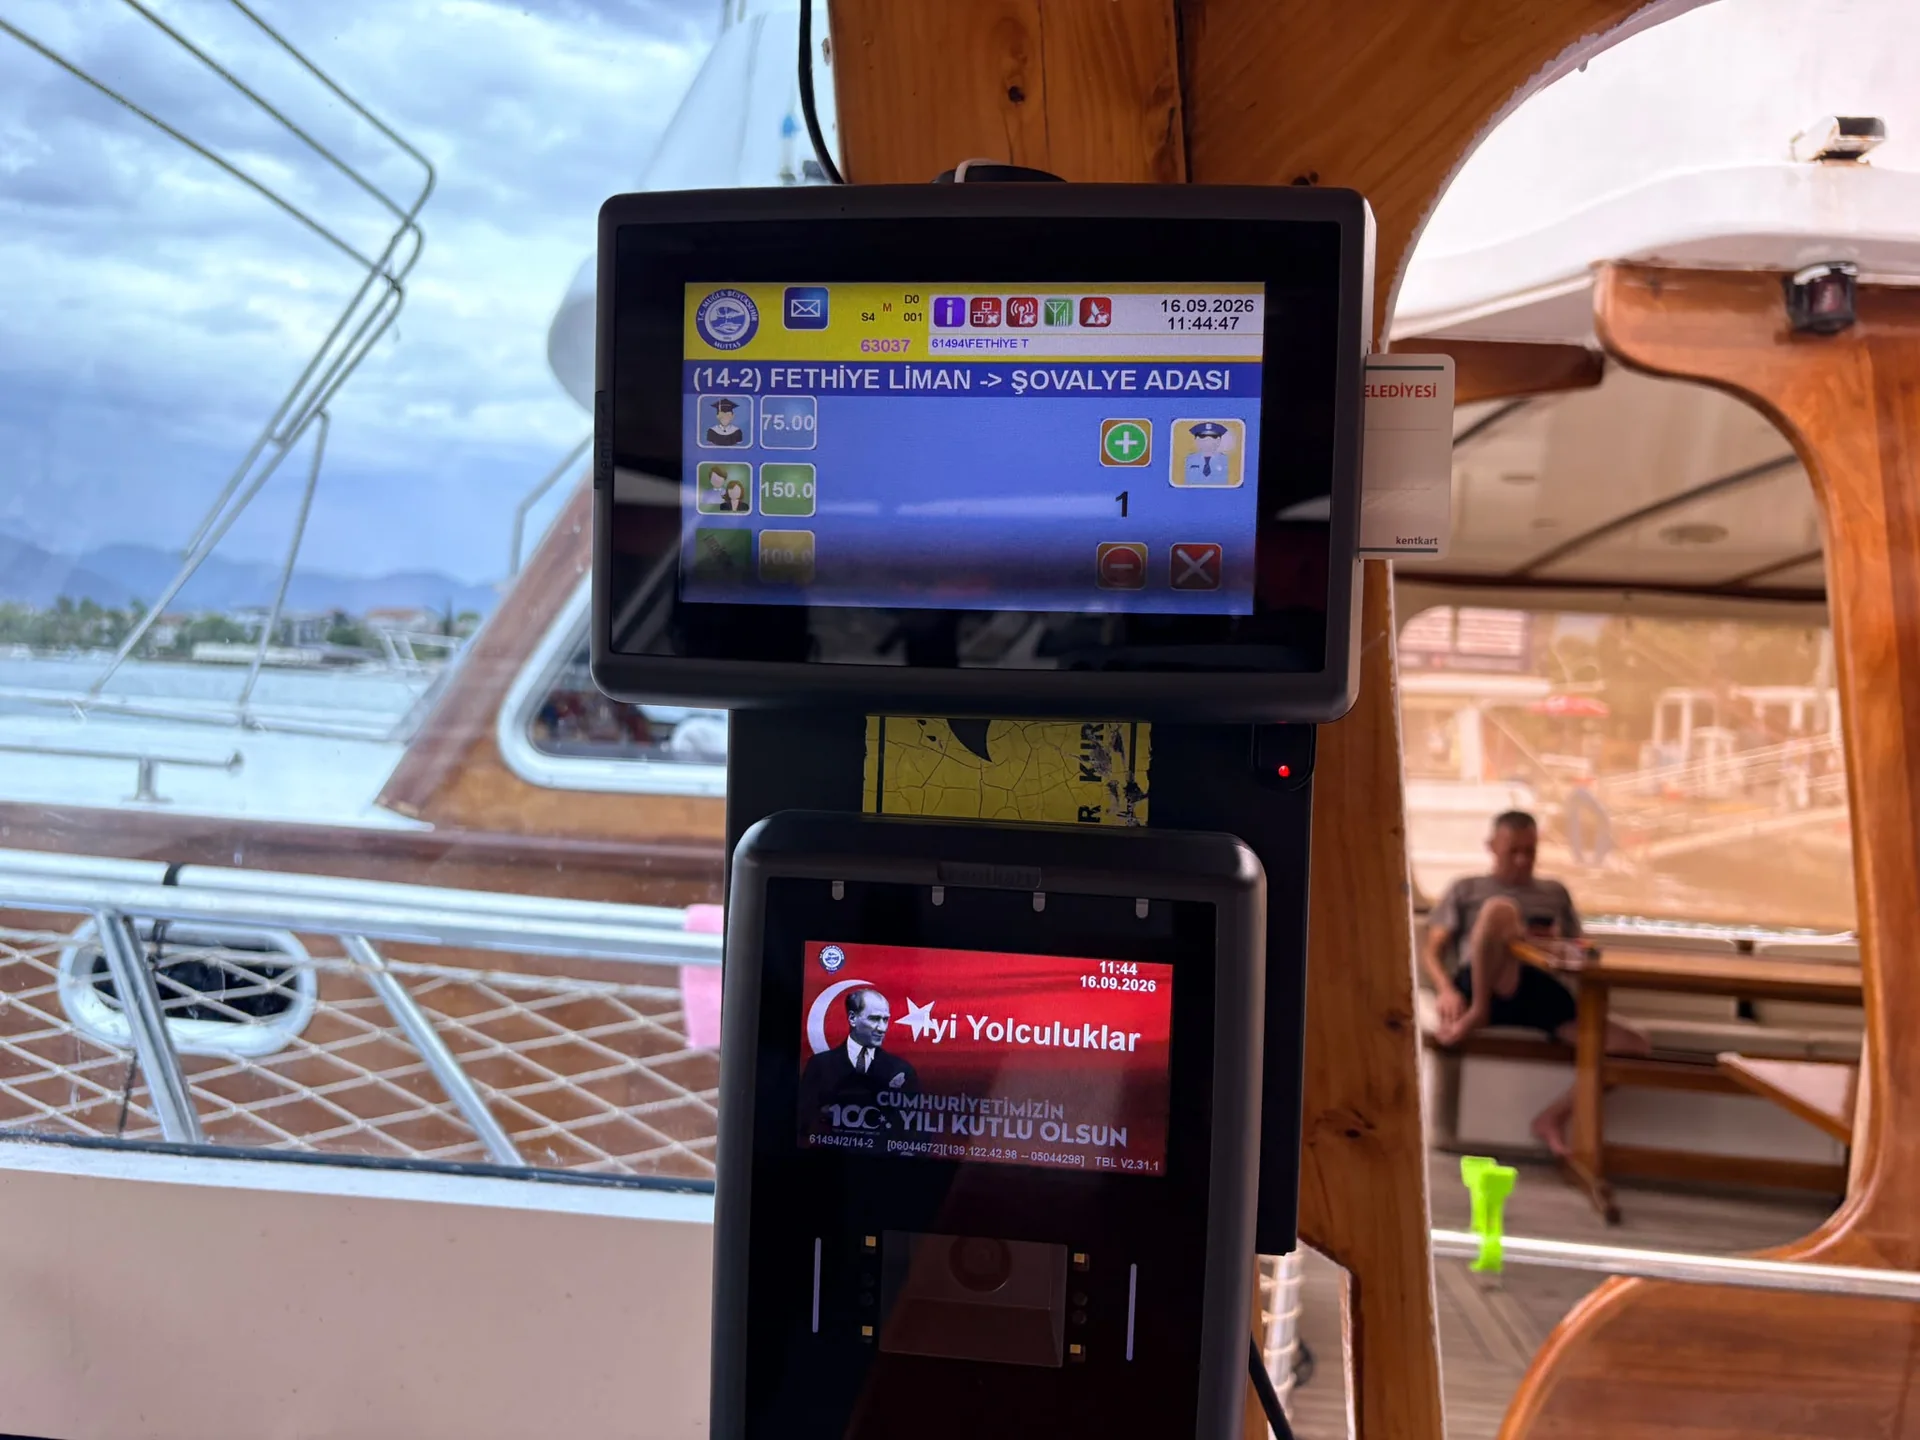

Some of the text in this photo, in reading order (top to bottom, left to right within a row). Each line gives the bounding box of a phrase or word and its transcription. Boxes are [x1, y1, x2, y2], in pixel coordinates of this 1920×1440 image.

[882, 303, 892, 312] M
[1161, 299, 1254, 313] 16.09.2026
[861, 312, 922, 322] S4 001
[1168, 316, 1240, 330] 11:44:47
[860, 339, 911, 354] 63037
[1021, 338, 1029, 349] T
[693, 367, 762, 392] (14-2)
[770, 365, 880, 389] FETHİYE
[889, 366, 971, 390] LİMAN
[1011, 369, 1137, 395] ŞOVALYE
[1144, 369, 1230, 391] ADASI
[761, 414, 815, 431] 75.00
[761, 482, 814, 498] 150.0
[1115, 491, 1128, 517] 1
[1395, 535, 1438, 546] kentkart
[1099, 961, 1138, 976] 11:44
[1080, 975, 1157, 992] 16.09.2026
[966, 1015, 1141, 1052] Yolculuklar
[876, 1091, 1064, 1120] CUMHURİYETİMİZİN
[900, 1110, 944, 1133] YILI
[951, 1114, 1033, 1140] KUTLU
[1039, 1121, 1127, 1147] OLSUN
[809, 1134, 874, 1148] 61494/2/14-2
[1095, 1156, 1117, 1168] TBL
[1120, 1157, 1159, 1171] V2.31.1
